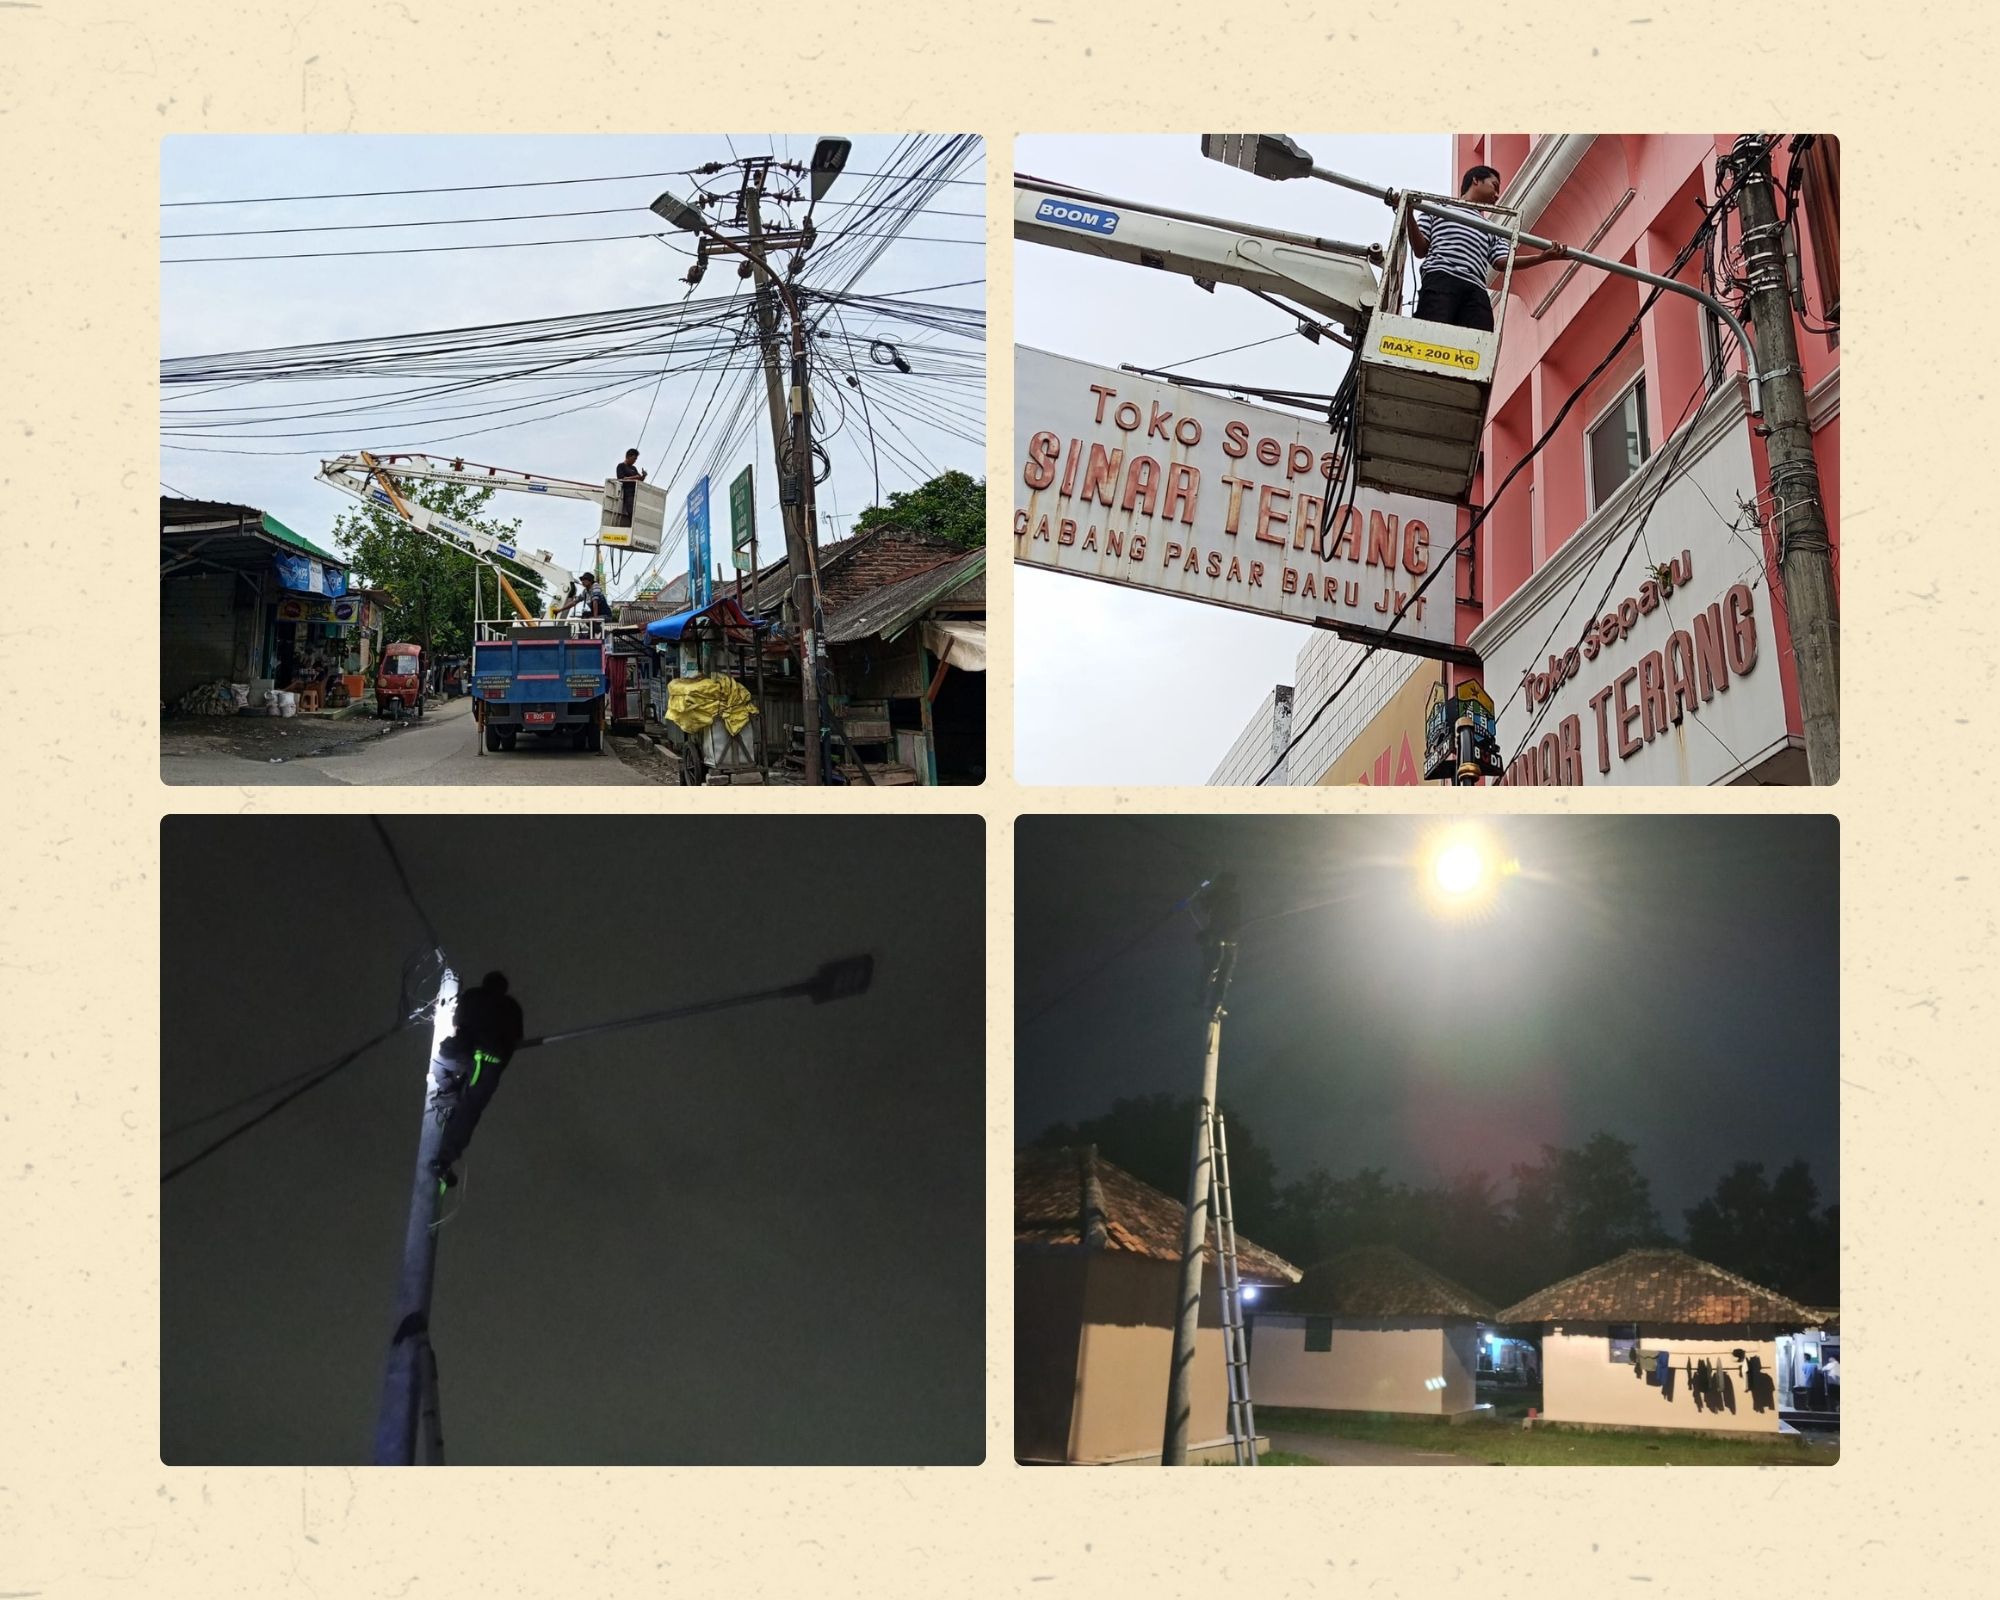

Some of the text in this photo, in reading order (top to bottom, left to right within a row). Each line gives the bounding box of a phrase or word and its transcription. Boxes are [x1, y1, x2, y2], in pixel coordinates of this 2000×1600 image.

[1039, 203, 1117, 230] BOOM 2
[1382, 340, 1415, 354] MAX
[1425, 348, 1451, 361] 200
[1454, 353, 1475, 366] KG
[1090, 384, 1203, 447] Toko
[1024, 431, 1430, 576] SINAR TERANG
[1013, 508, 1427, 621] CABANG PASAR BARU JKT
[1589, 583, 1759, 774] TERANG
